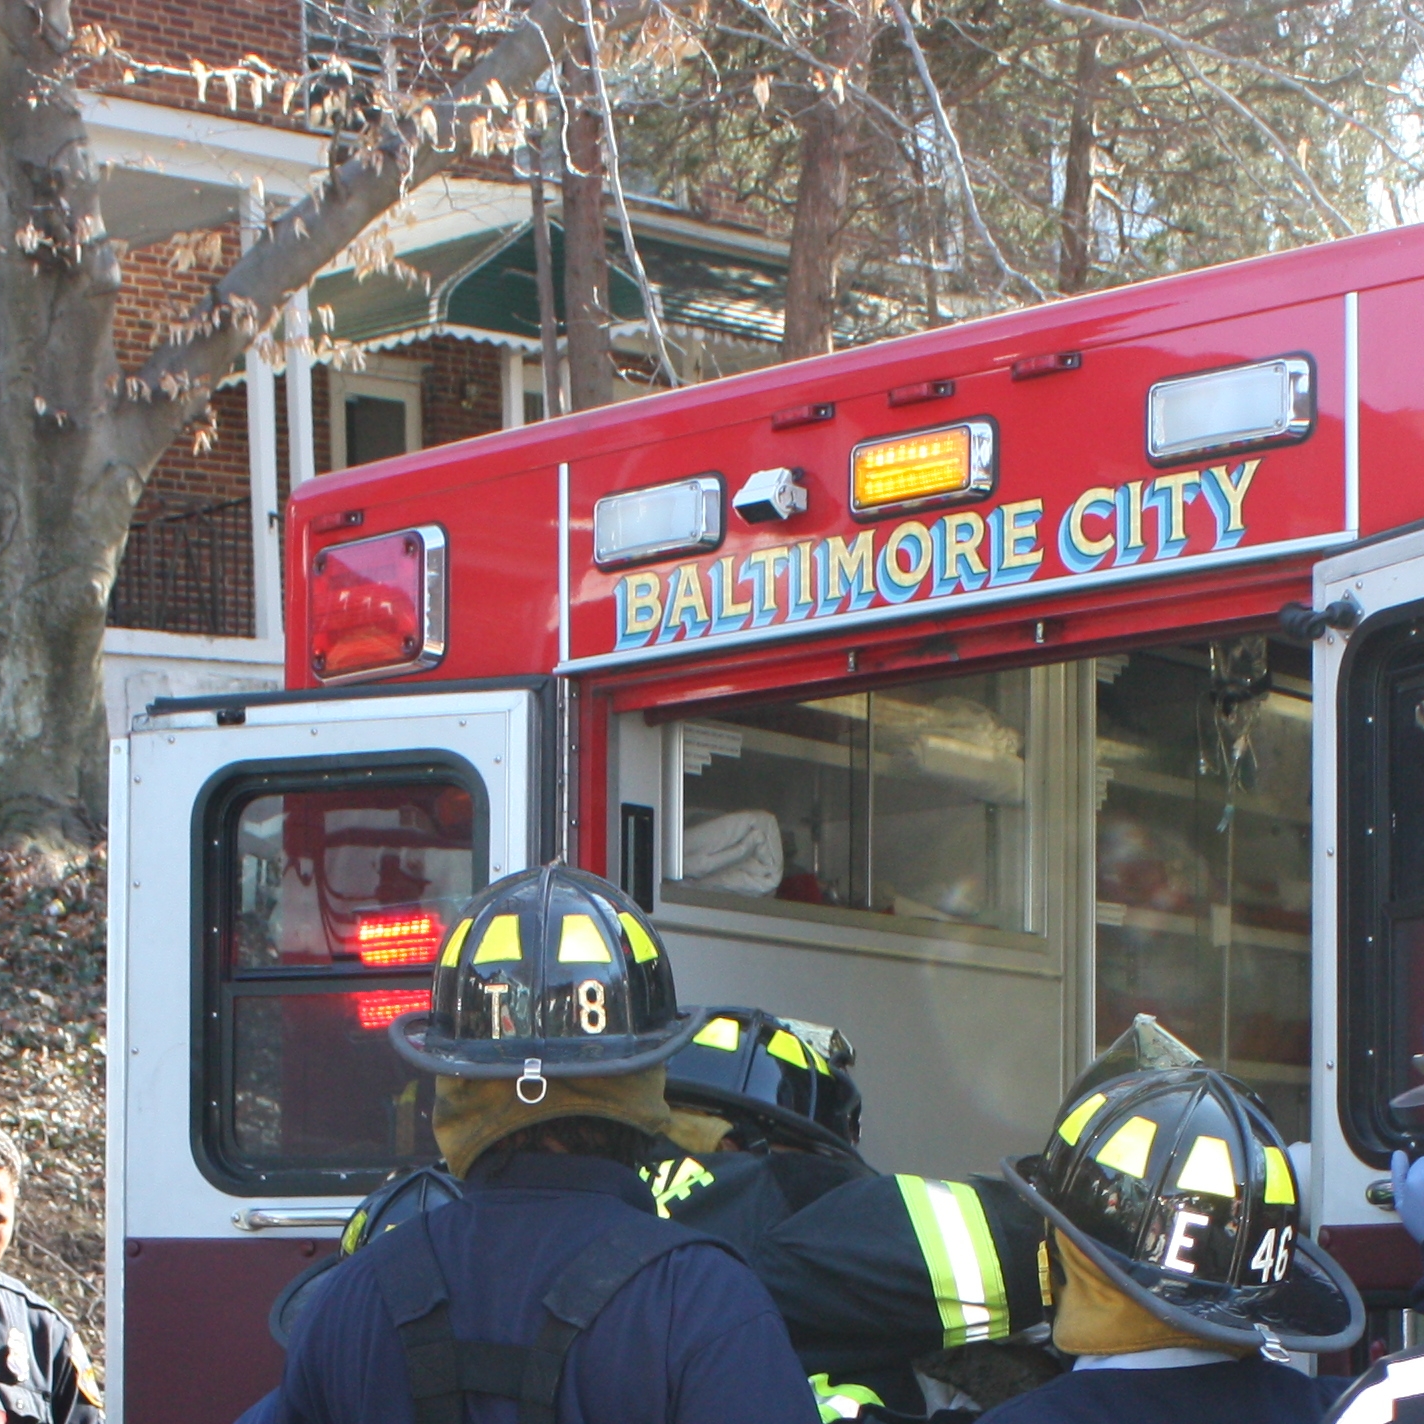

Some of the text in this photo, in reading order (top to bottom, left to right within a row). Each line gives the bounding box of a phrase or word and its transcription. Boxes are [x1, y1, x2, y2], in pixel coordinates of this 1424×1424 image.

[614, 458, 1265, 651] BALTIMORE CITY
[484, 979, 607, 1040] T 8
[1164, 1211, 1293, 1284] E 46
